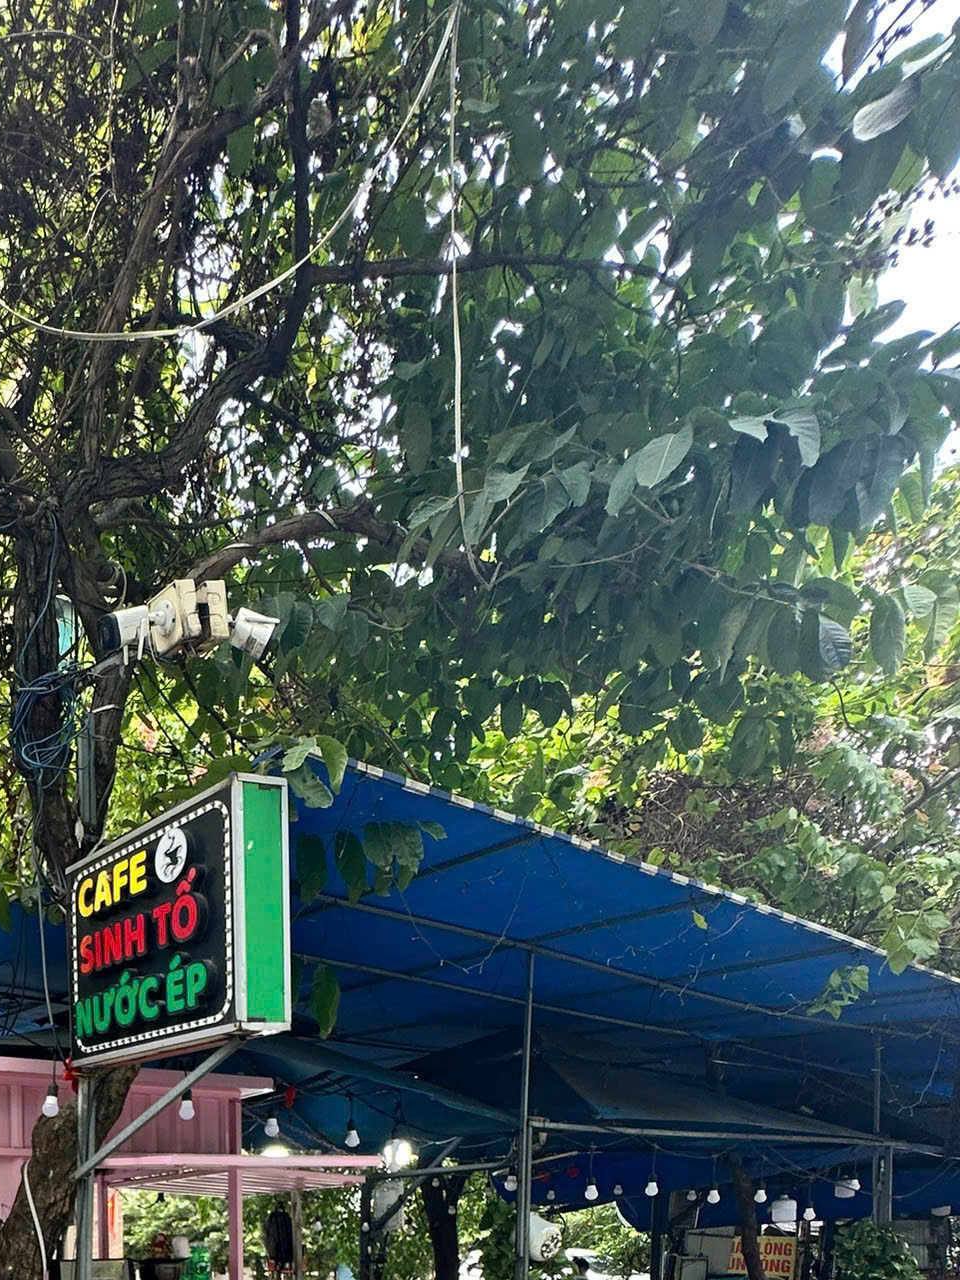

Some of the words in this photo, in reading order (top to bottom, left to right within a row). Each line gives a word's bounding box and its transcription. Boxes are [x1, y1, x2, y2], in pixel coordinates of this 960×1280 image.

[78, 850, 147, 918] CAFE
[80, 912, 145, 974] SINH
[152, 866, 197, 946] TỐ
[76, 970, 159, 1038] NƯỚC
[167, 954, 208, 1014] ÉP
